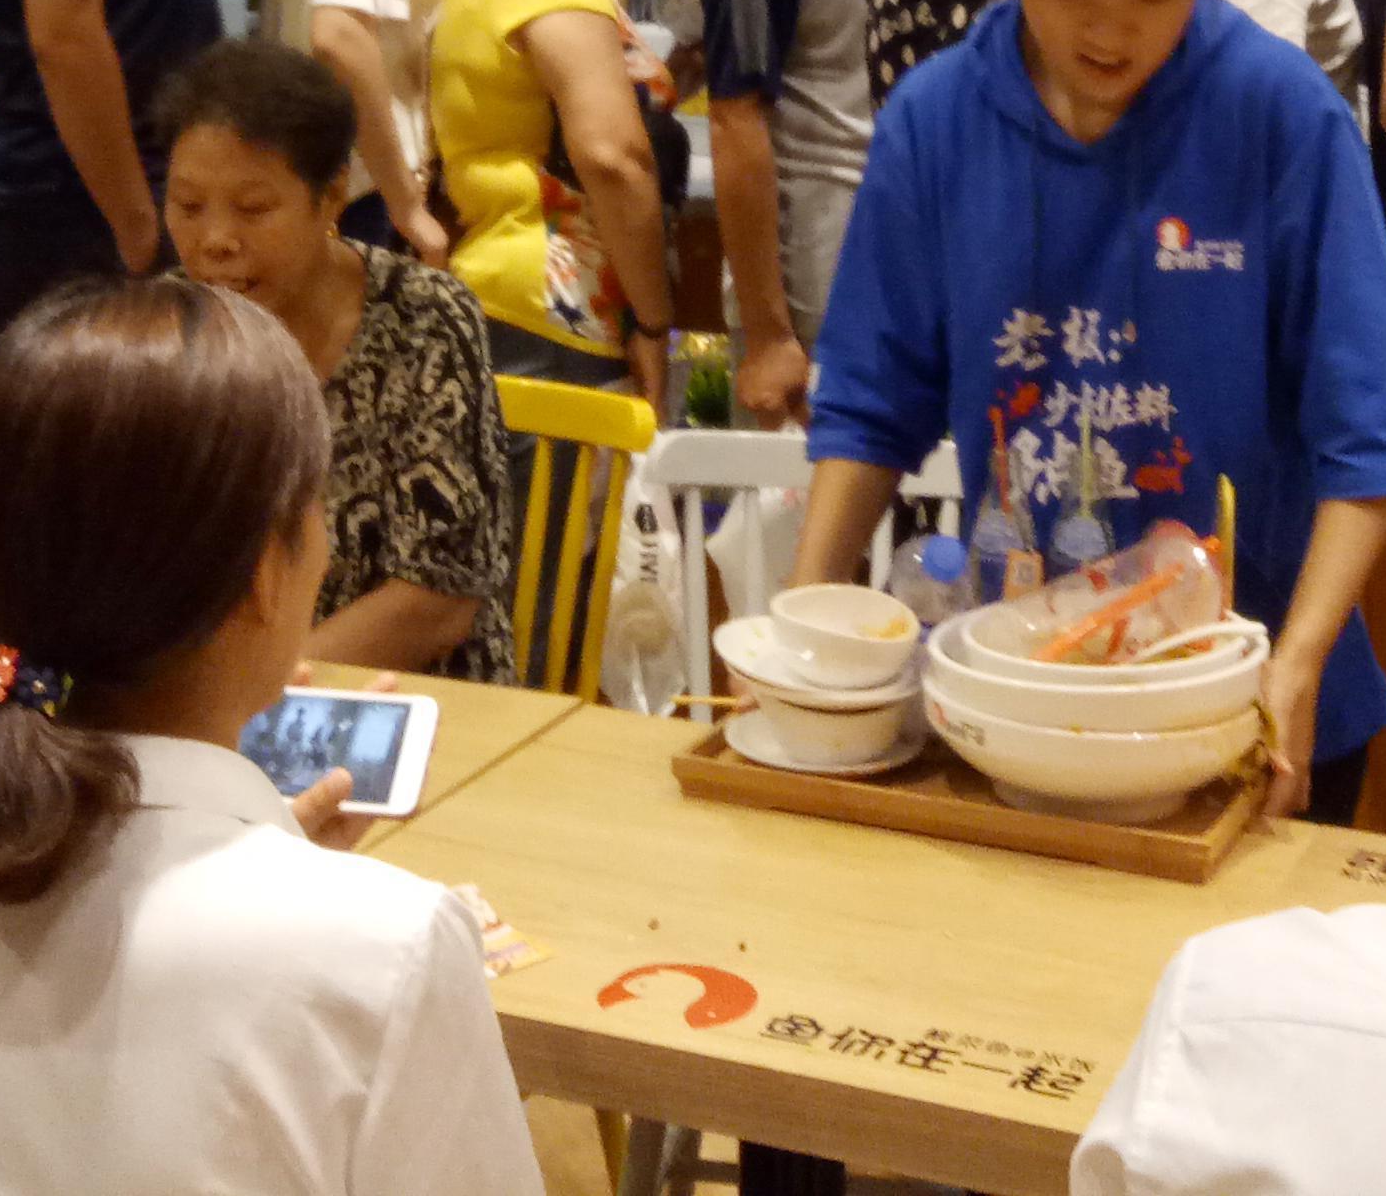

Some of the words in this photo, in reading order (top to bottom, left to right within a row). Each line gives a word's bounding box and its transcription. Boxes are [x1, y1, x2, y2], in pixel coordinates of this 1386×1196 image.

[759, 1012, 1087, 1101] 鱼你在一起
